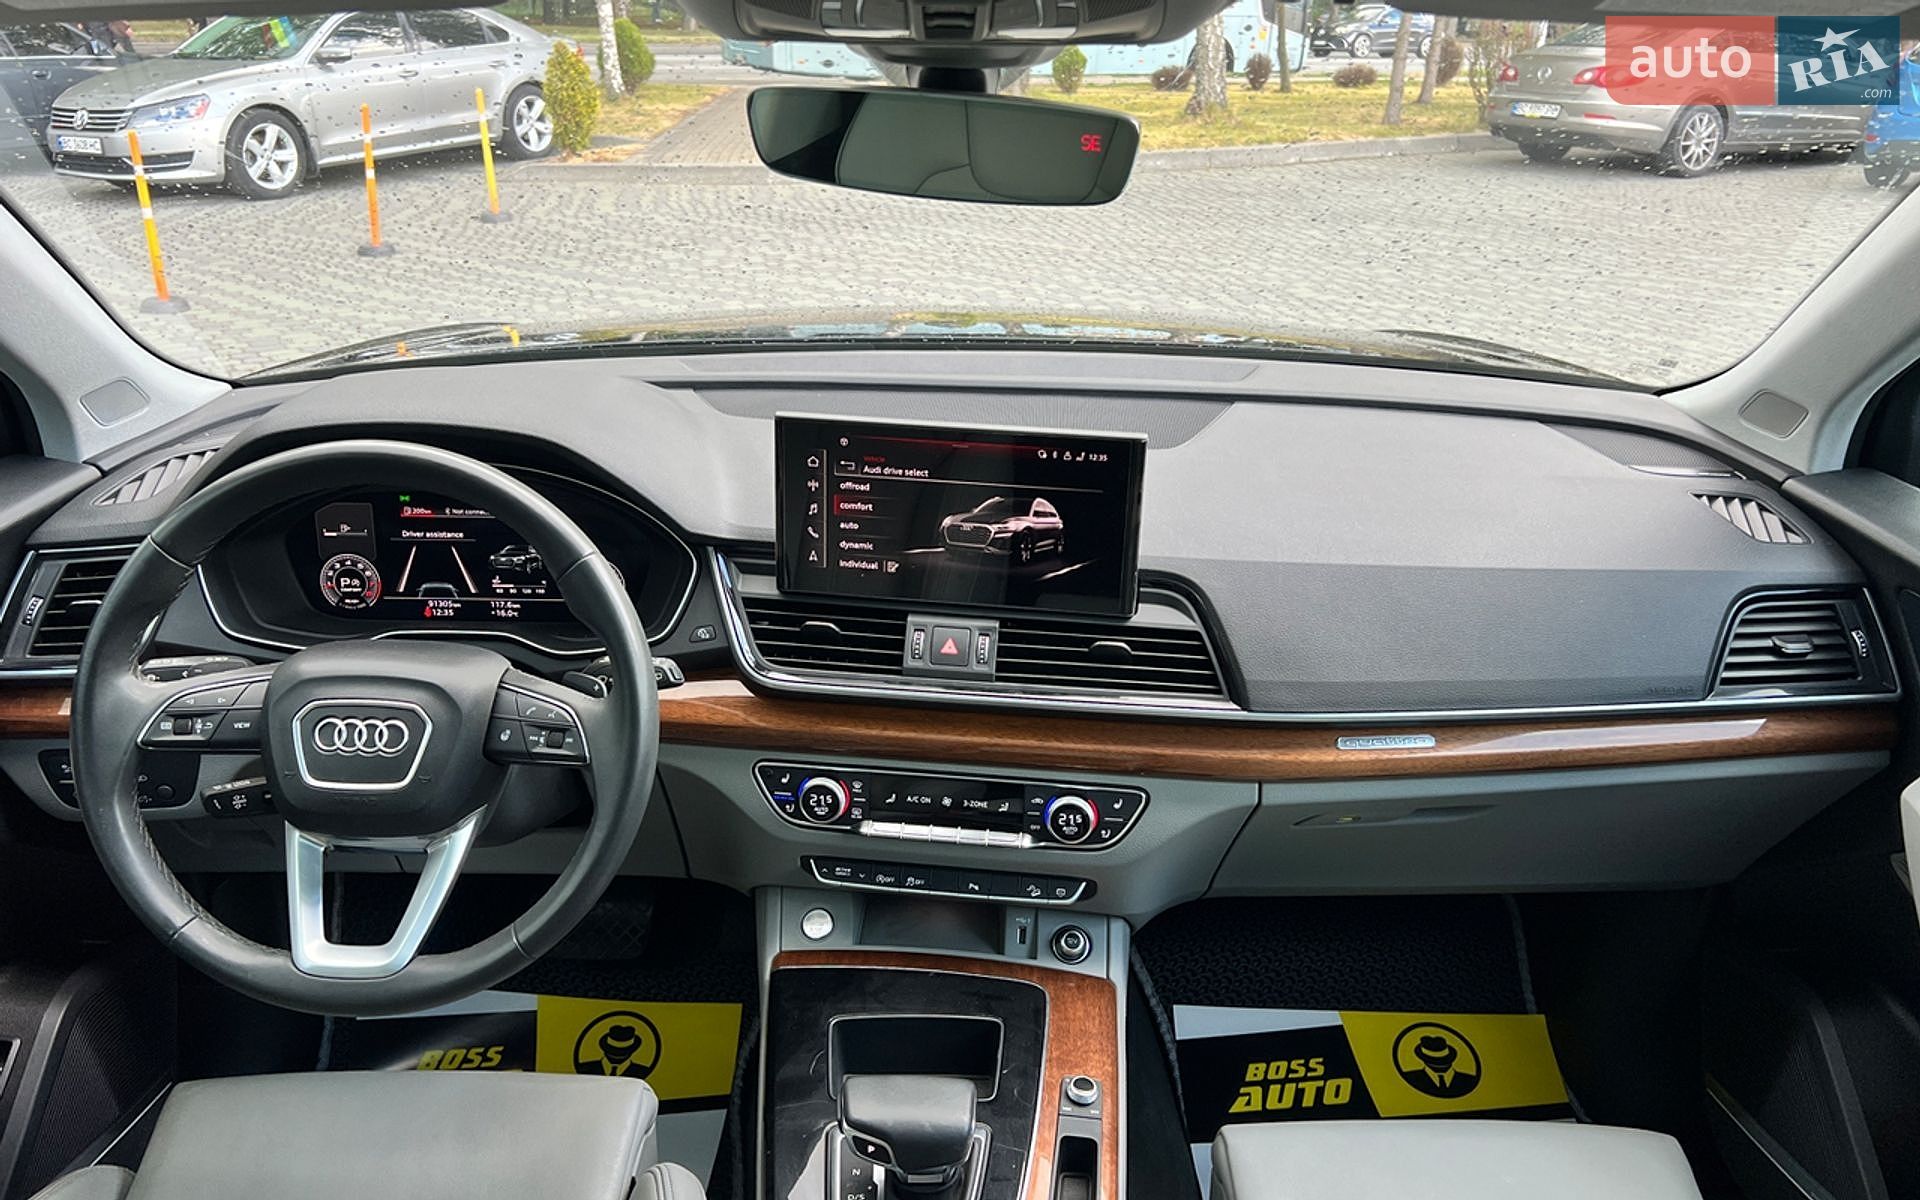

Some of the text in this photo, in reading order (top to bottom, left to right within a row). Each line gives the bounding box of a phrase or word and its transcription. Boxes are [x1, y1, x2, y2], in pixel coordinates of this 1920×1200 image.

[1080, 133, 1102, 152] SE
[863, 465, 929, 478] Audi drive select
[839, 482, 870, 492] offroad
[839, 501, 873, 512] comfort
[839, 521, 859, 530] auto
[401, 530, 464, 539] Driver assistance
[839, 540, 873, 552] dynamic
[839, 559, 879, 570] individual
[340, 577, 350, 588] P
[233, 721, 251, 729] VIEW
[418, 1045, 505, 1071] BOSS
[1244, 1057, 1324, 1083] BOSS
[1228, 1078, 1353, 1114] AUTO
[867, 1144, 876, 1153] P
[852, 1168, 861, 1176] N
